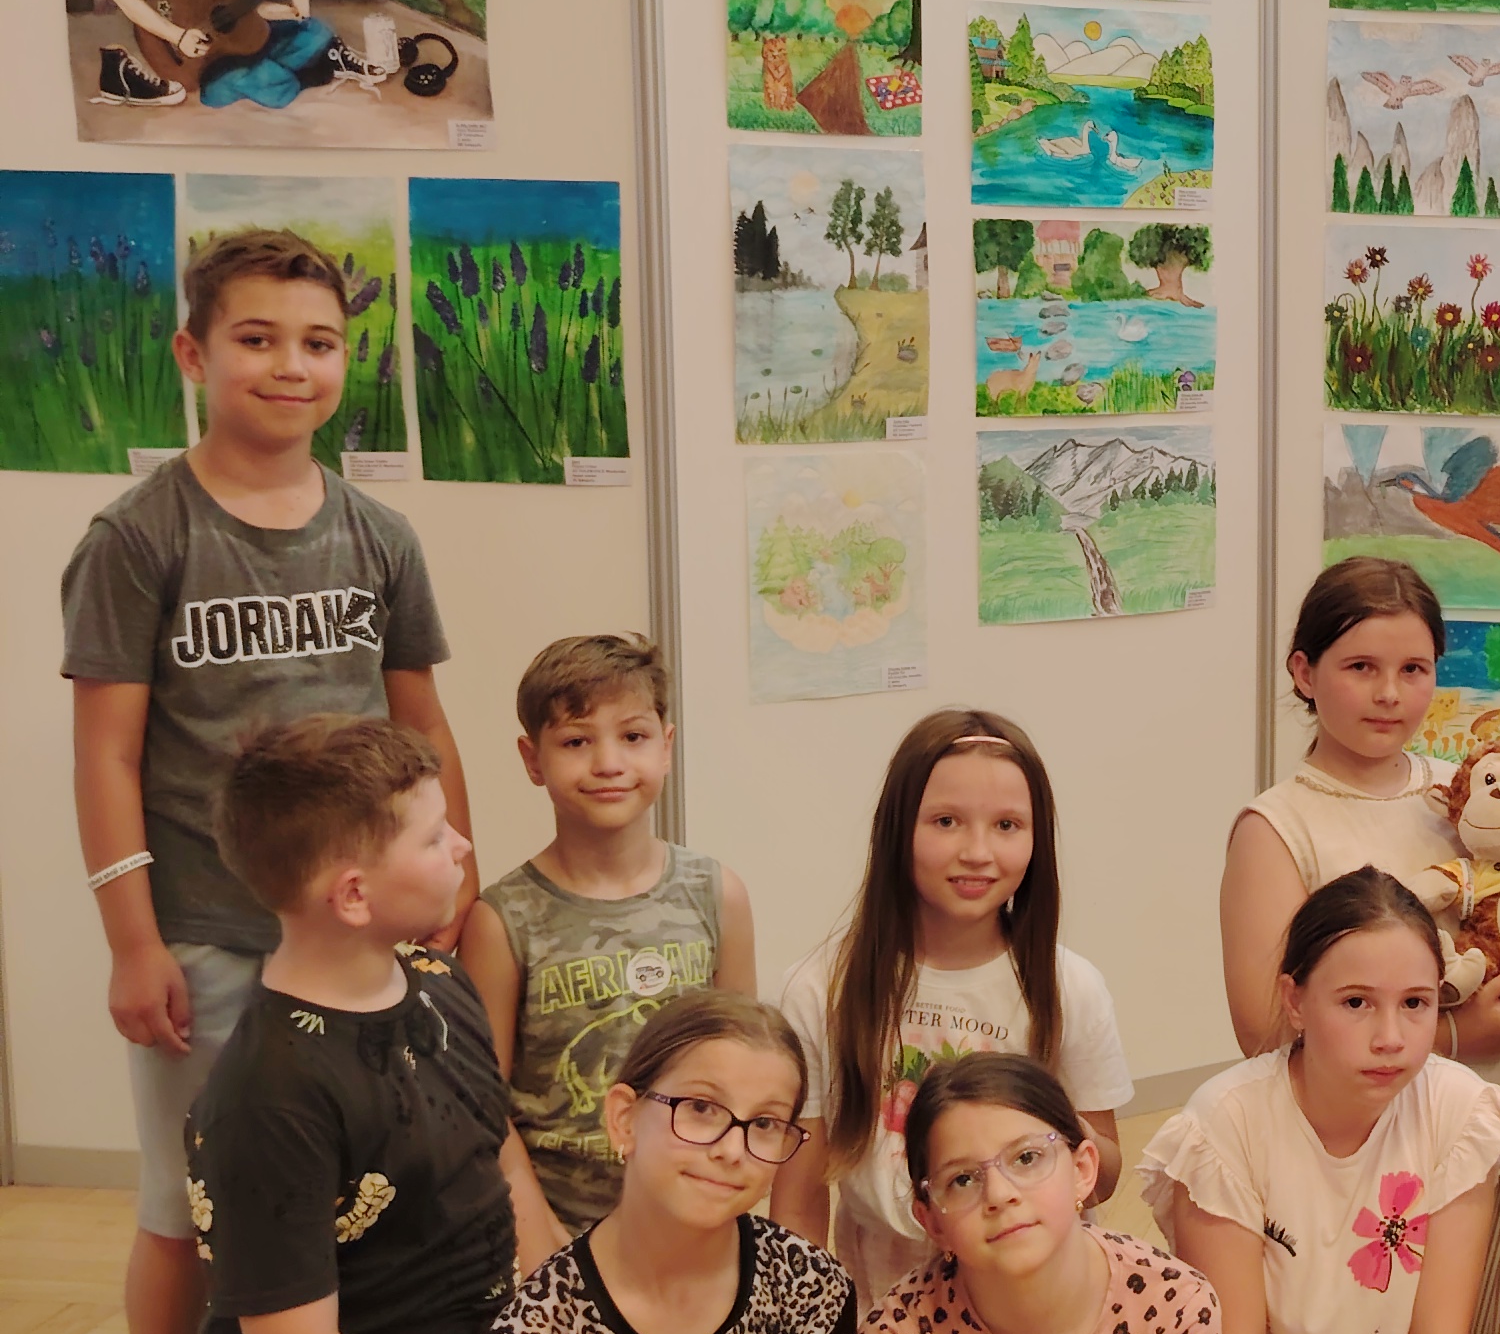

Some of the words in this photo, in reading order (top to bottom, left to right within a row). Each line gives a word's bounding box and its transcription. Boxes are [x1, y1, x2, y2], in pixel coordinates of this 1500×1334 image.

[173, 589, 353, 667] JORDAN
[540, 940, 712, 1016] AFRIAN
[949, 1015, 1009, 1042] MOOD
